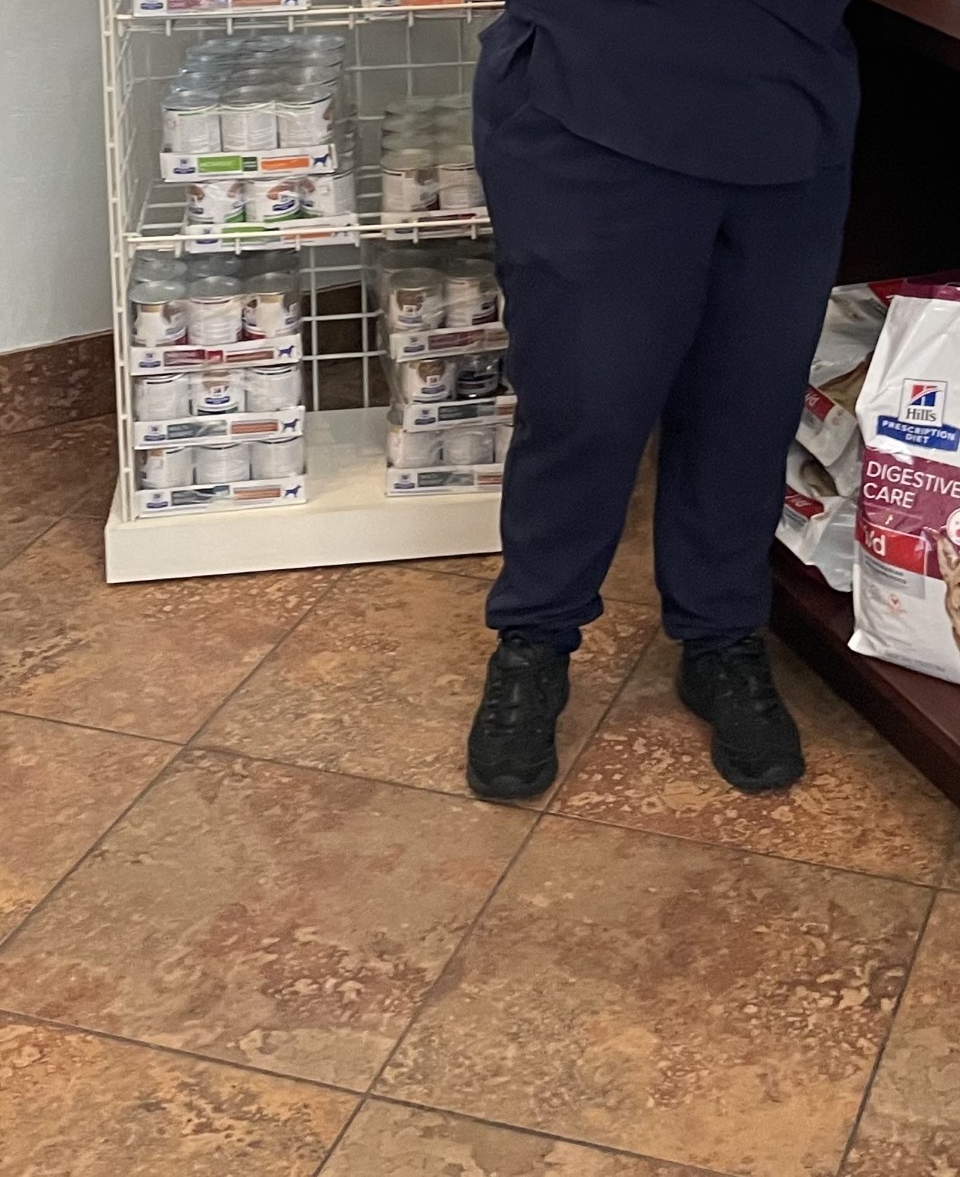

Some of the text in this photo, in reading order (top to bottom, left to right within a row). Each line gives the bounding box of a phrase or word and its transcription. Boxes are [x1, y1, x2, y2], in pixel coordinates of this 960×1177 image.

[905, 408, 937, 422] Hill's
[882, 420, 956, 441] PRESCRIPTION
[905, 433, 930, 444] DIET
[863, 483, 917, 510] CARE
